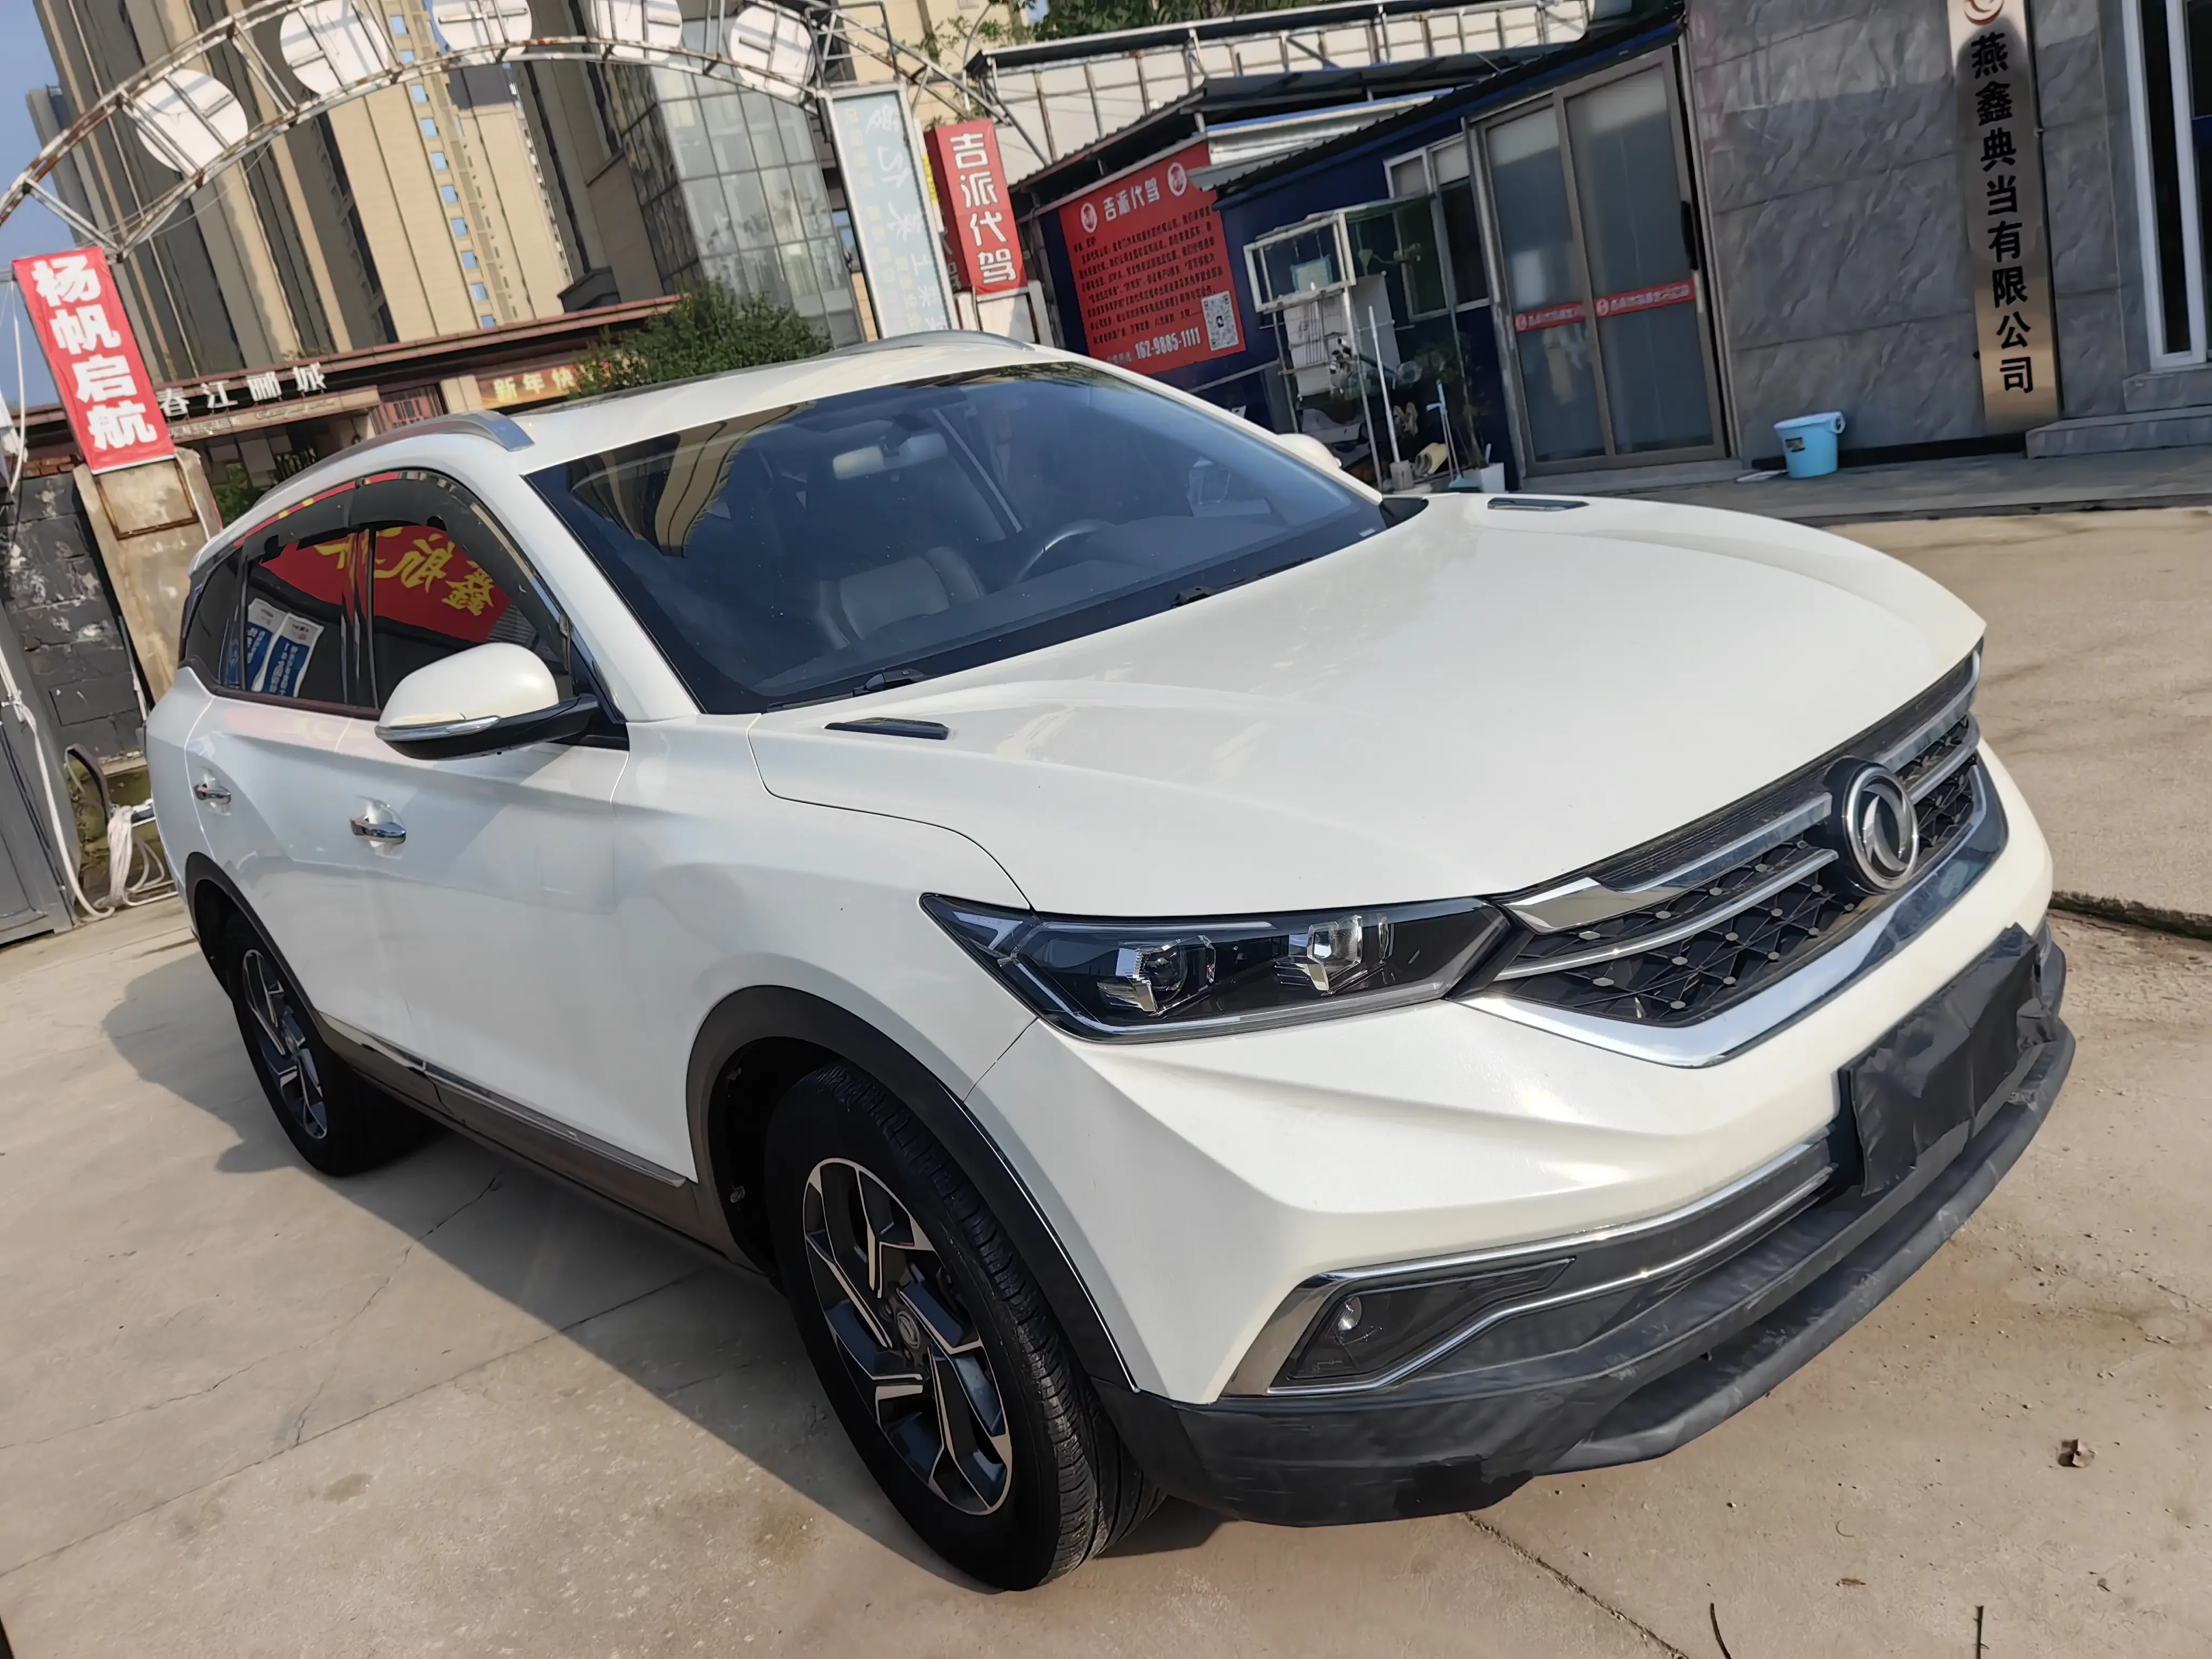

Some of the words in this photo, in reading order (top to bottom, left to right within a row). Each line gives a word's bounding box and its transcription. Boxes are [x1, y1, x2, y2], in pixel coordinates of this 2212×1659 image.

[949, 133, 1017, 285] 吉派代驾
[1970, 31, 2034, 394] 燕鑫典当有限公司
[492, 364, 595, 404] 新年快
